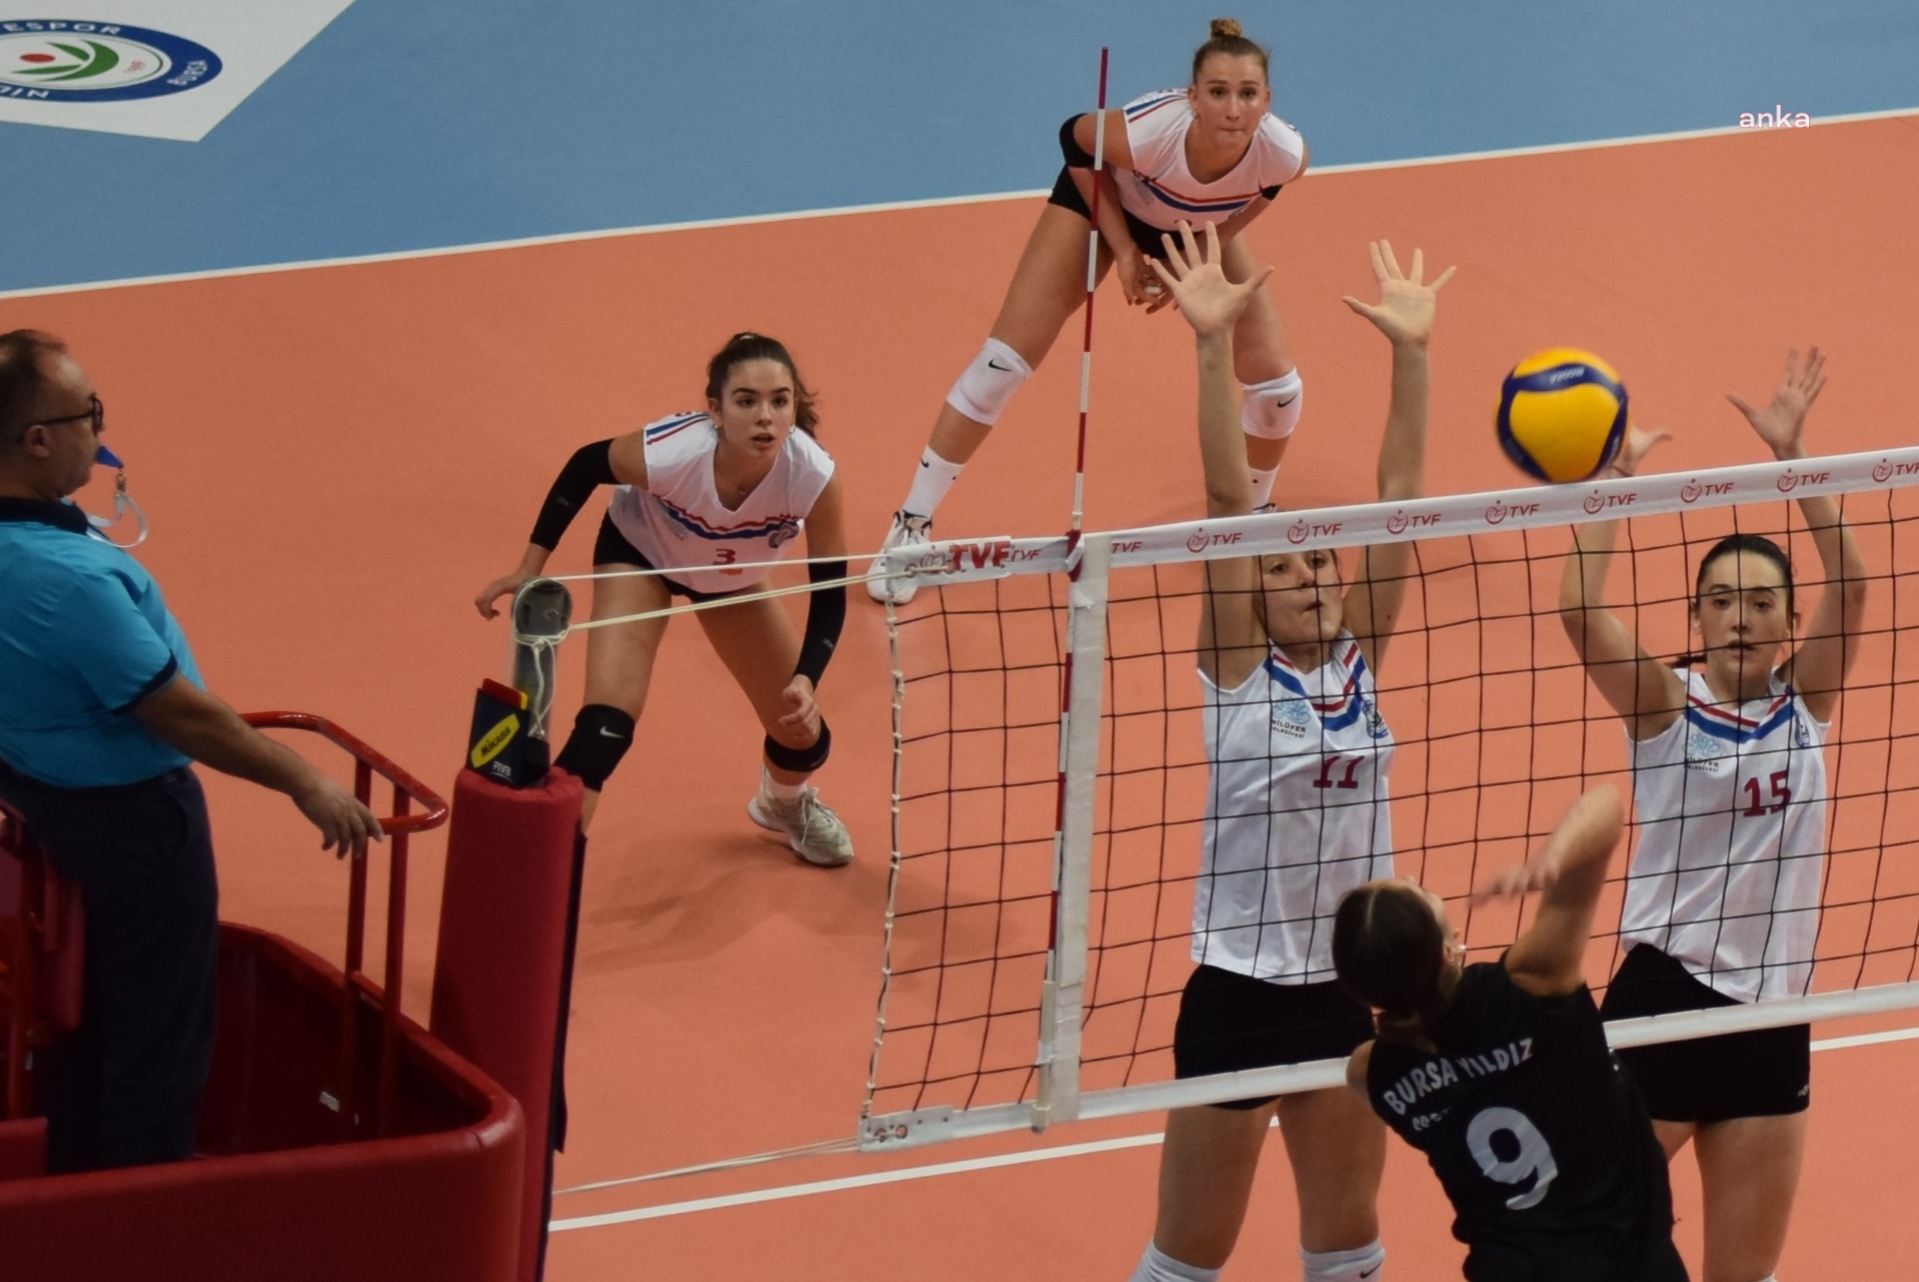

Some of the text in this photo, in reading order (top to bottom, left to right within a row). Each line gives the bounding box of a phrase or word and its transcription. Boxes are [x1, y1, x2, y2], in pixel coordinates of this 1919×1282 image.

[1801, 472, 1830, 486] TVF
[1704, 482, 1734, 496] TVF
[1607, 493, 1638, 508] TVF
[1509, 503, 1540, 518] TVF
[1411, 513, 1442, 528] TVF
[1312, 522, 1343, 537] TVF
[1213, 532, 1243, 546] TVF
[1111, 541, 1143, 554] TVF
[712, 548, 736, 566] 3
[949, 541, 1011, 571] TVF
[1313, 756, 1365, 788] 11
[1743, 770, 1792, 817] 15
[1383, 1038, 1533, 1115] BURSA YILDIZ
[1466, 1107, 1558, 1210] 9
